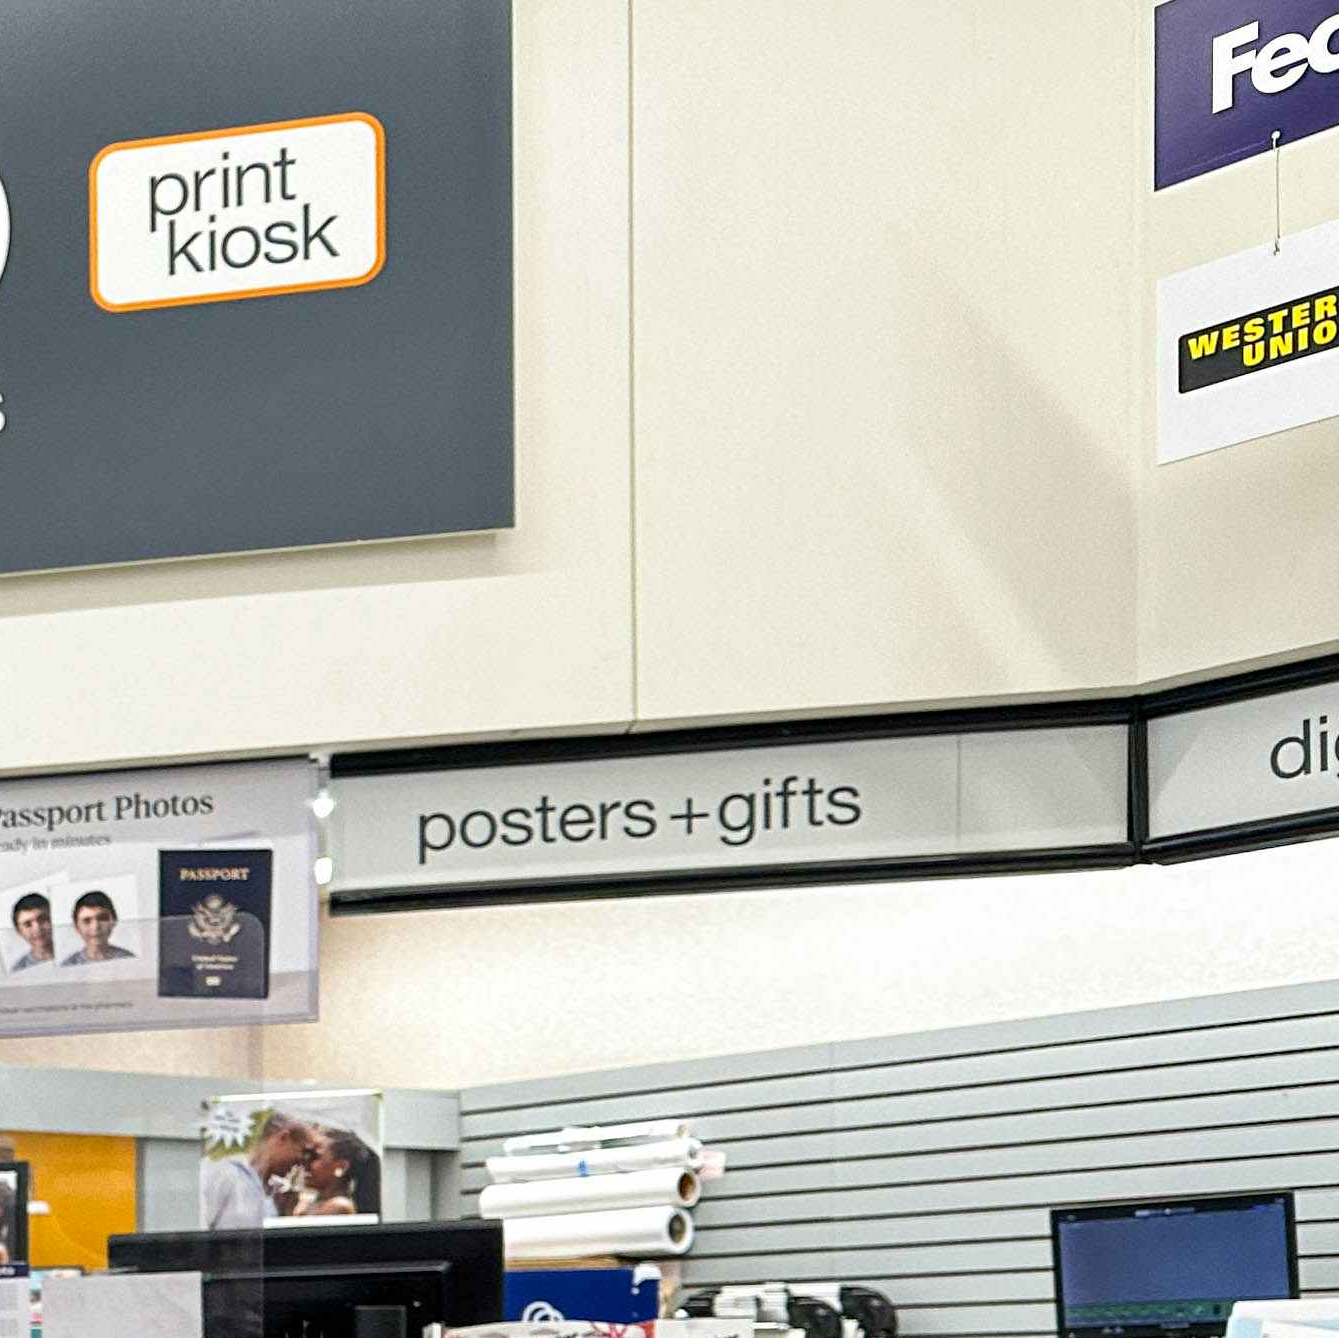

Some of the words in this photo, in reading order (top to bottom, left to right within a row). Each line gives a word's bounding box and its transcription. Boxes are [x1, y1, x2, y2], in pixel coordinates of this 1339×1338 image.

[150, 148, 299, 230] print
[169, 205, 343, 279] kiosk
[1270, 714, 1339, 780] di
[114, 792, 213, 820] Photos
[51, 834, 111, 847] minutes
[180, 867, 250, 881] PASSPORT
